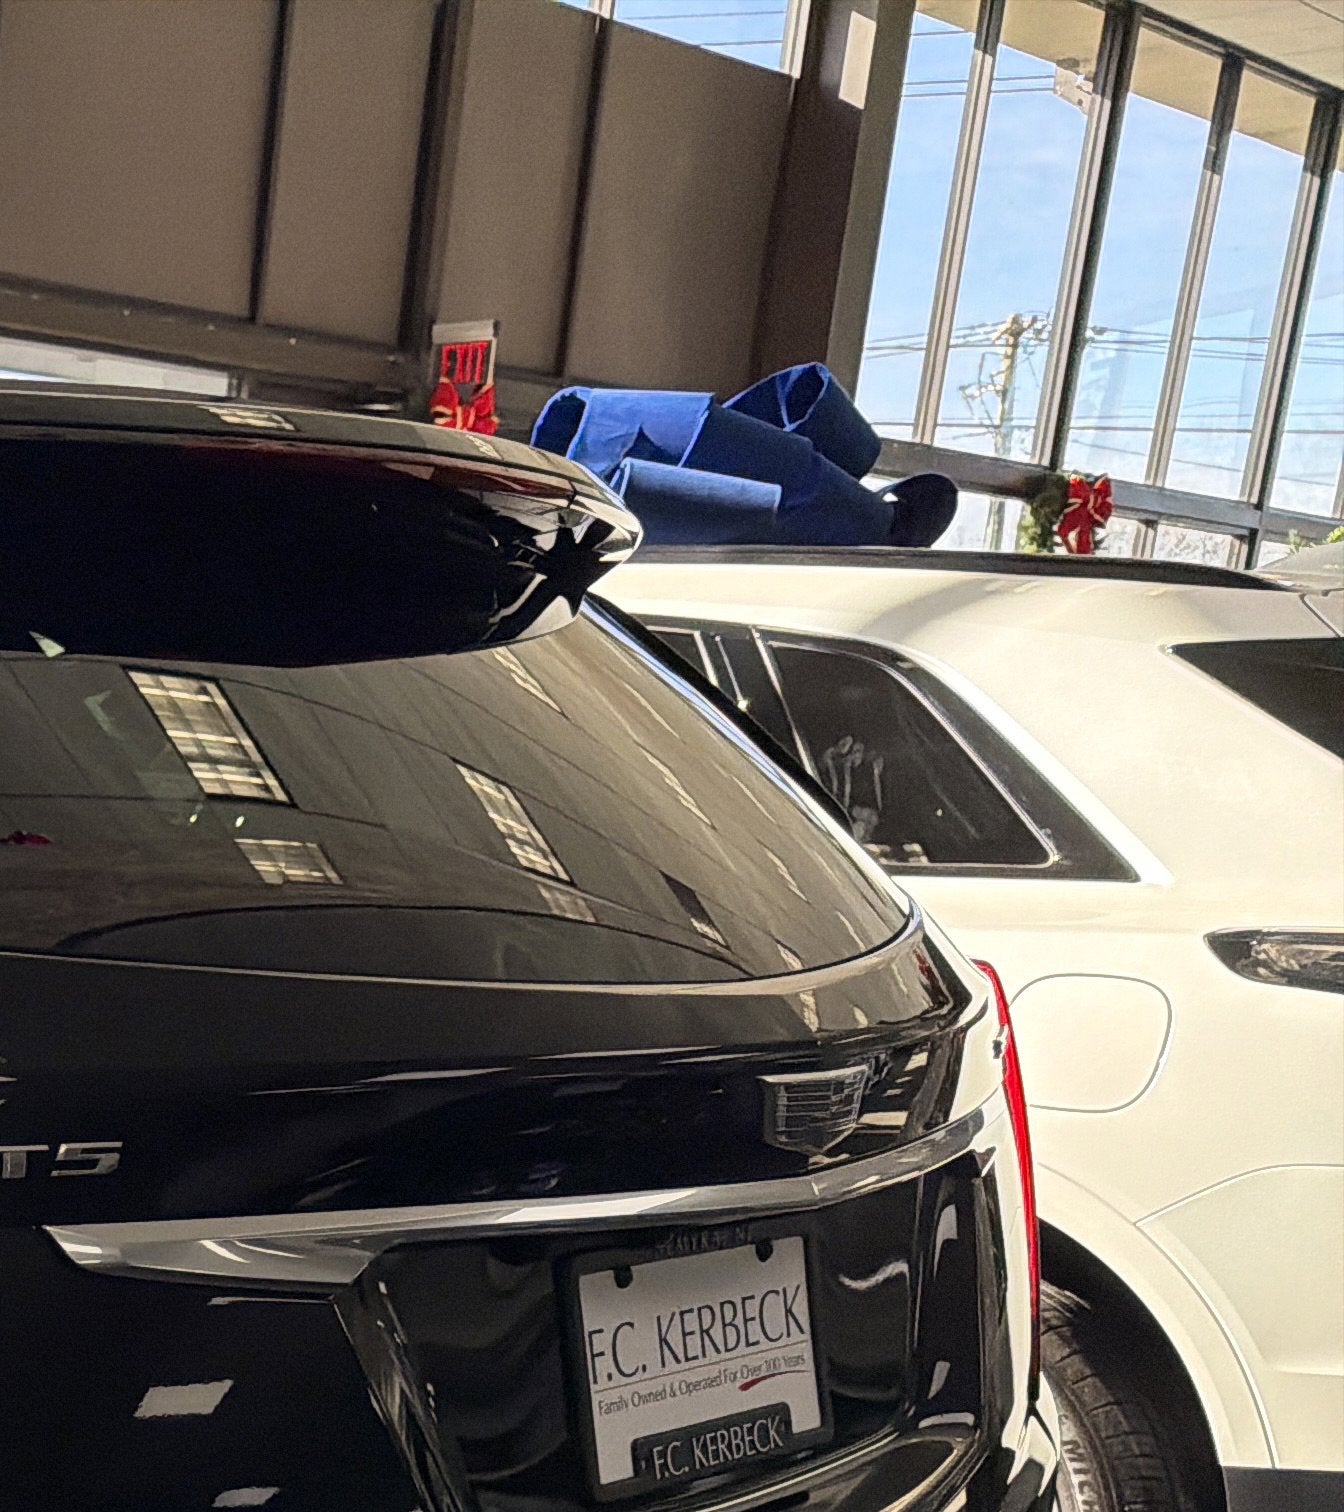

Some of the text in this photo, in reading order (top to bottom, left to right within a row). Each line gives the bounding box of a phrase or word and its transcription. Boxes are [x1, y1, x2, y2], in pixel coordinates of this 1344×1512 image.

[440, 341, 489, 384] EXIT
[587, 1283, 806, 1386] F.C. KERBECK
[598, 1396, 629, 1416] Family
[631, 1384, 668, 1409] Owned
[740, 1363, 764, 1380] Over
[652, 1415, 785, 1481] F.C. KERBECK
